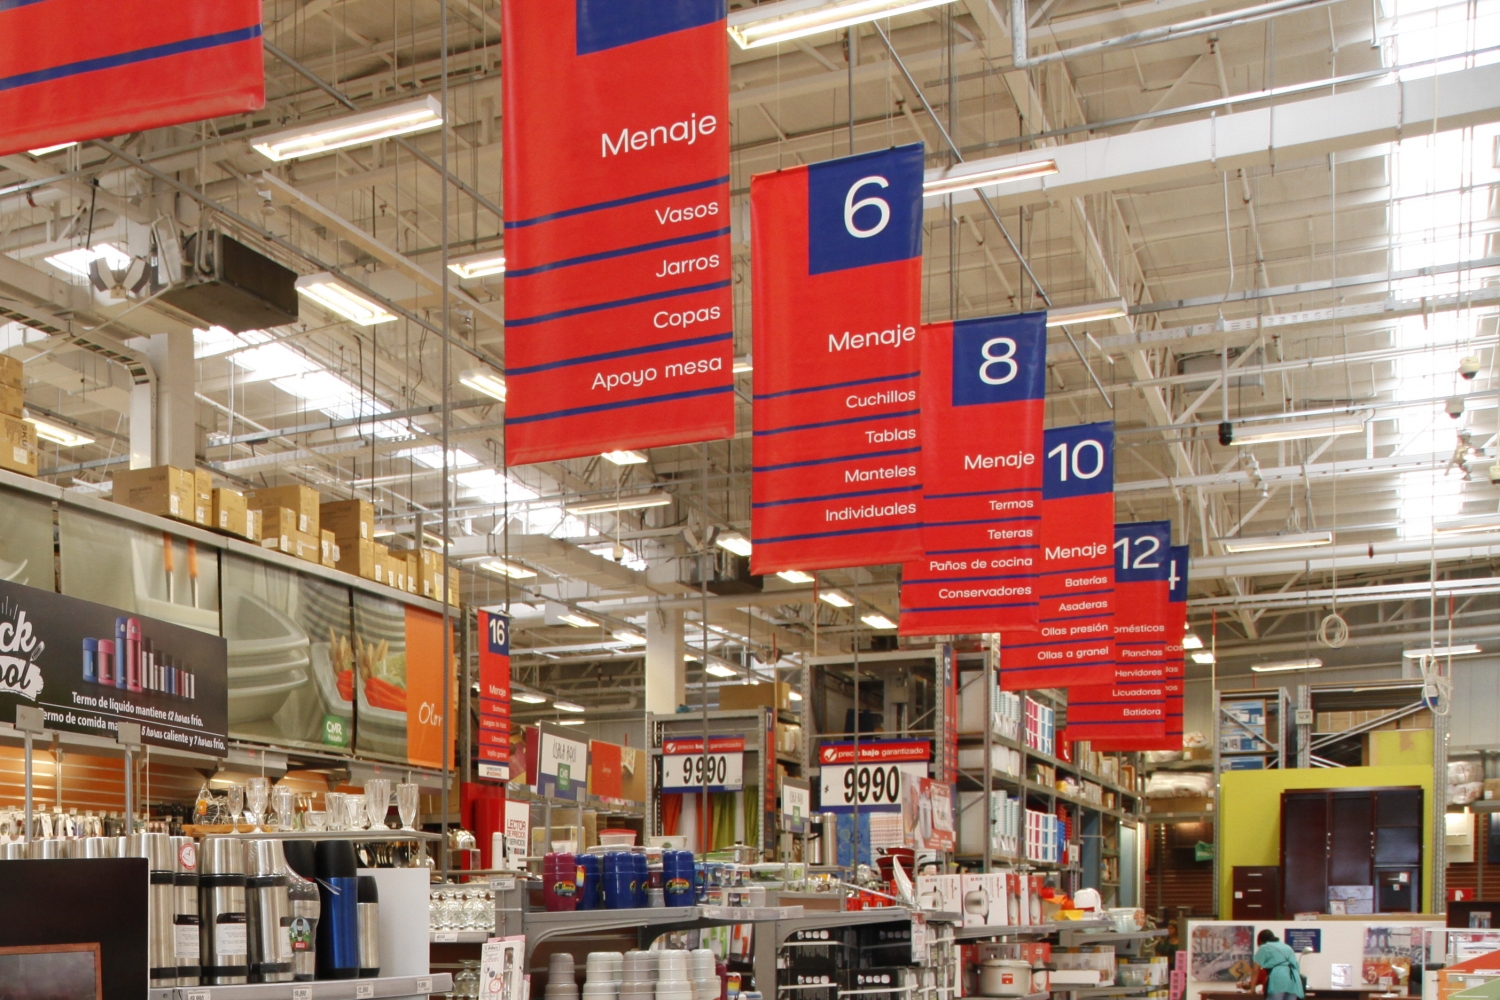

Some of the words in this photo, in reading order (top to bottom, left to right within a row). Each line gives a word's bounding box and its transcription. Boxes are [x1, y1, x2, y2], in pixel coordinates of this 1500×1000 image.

[601, 112, 717, 159] Menaje
[655, 201, 719, 226] Vasos
[843, 175, 891, 239] 6
[655, 254, 720, 278] Jarros
[653, 305, 721, 329] Copas
[828, 323, 917, 352] Menaje
[979, 337, 1018, 386] 8
[591, 368, 658, 391] Apoyo
[664, 357, 722, 378] mesa
[845, 389, 916, 409] Cuchillos
[864, 427, 916, 444] Tablas
[964, 451, 1035, 471] Menaje
[1047, 439, 1104, 482] 10
[844, 464, 916, 483] Manteles
[825, 502, 916, 522] Individuales
[989, 498, 1034, 511] Termos
[987, 528, 1033, 540] Teteras
[1045, 541, 1107, 561] Menaje
[1112, 535, 1160, 570] 12
[929, 559, 967, 571] Paños
[970, 558, 987, 569] de
[990, 557, 1033, 569] cocina
[1065, 574, 1108, 588] Baterías
[938, 585, 1032, 599] Conservadores
[1058, 599, 1108, 612] Asaderas
[489, 618, 506, 646] 16
[1041, 625, 1067, 637] Ollas
[1070, 622, 1109, 636] presión
[1037, 649, 1063, 661] Ollas
[1076, 646, 1109, 660] granel
[1122, 647, 1163, 658] Planchas
[1115, 666, 1162, 677] Hervidores
[1112, 687, 1161, 698] Licuadoras
[72, 691, 98, 707] Termo
[98, 698, 109, 708] de
[109, 698, 135, 714] líquido
[135, 706, 167, 720] mantiene
[174, 711, 191, 725] horas
[418, 701, 443, 727] Olor
[1123, 707, 1161, 717] Batidora
[65, 712, 76, 724] de
[77, 715, 106, 731] comida
[163, 729, 189, 743] caliente
[326, 720, 343, 735] CMR
[862, 749, 880, 757] bajo
[882, 747, 924, 757] garantizado
[683, 756, 727, 785] 9990
[844, 765, 900, 804] 9990
[507, 819, 526, 830] LECTOR
[1193, 938, 1224, 954] SUB
